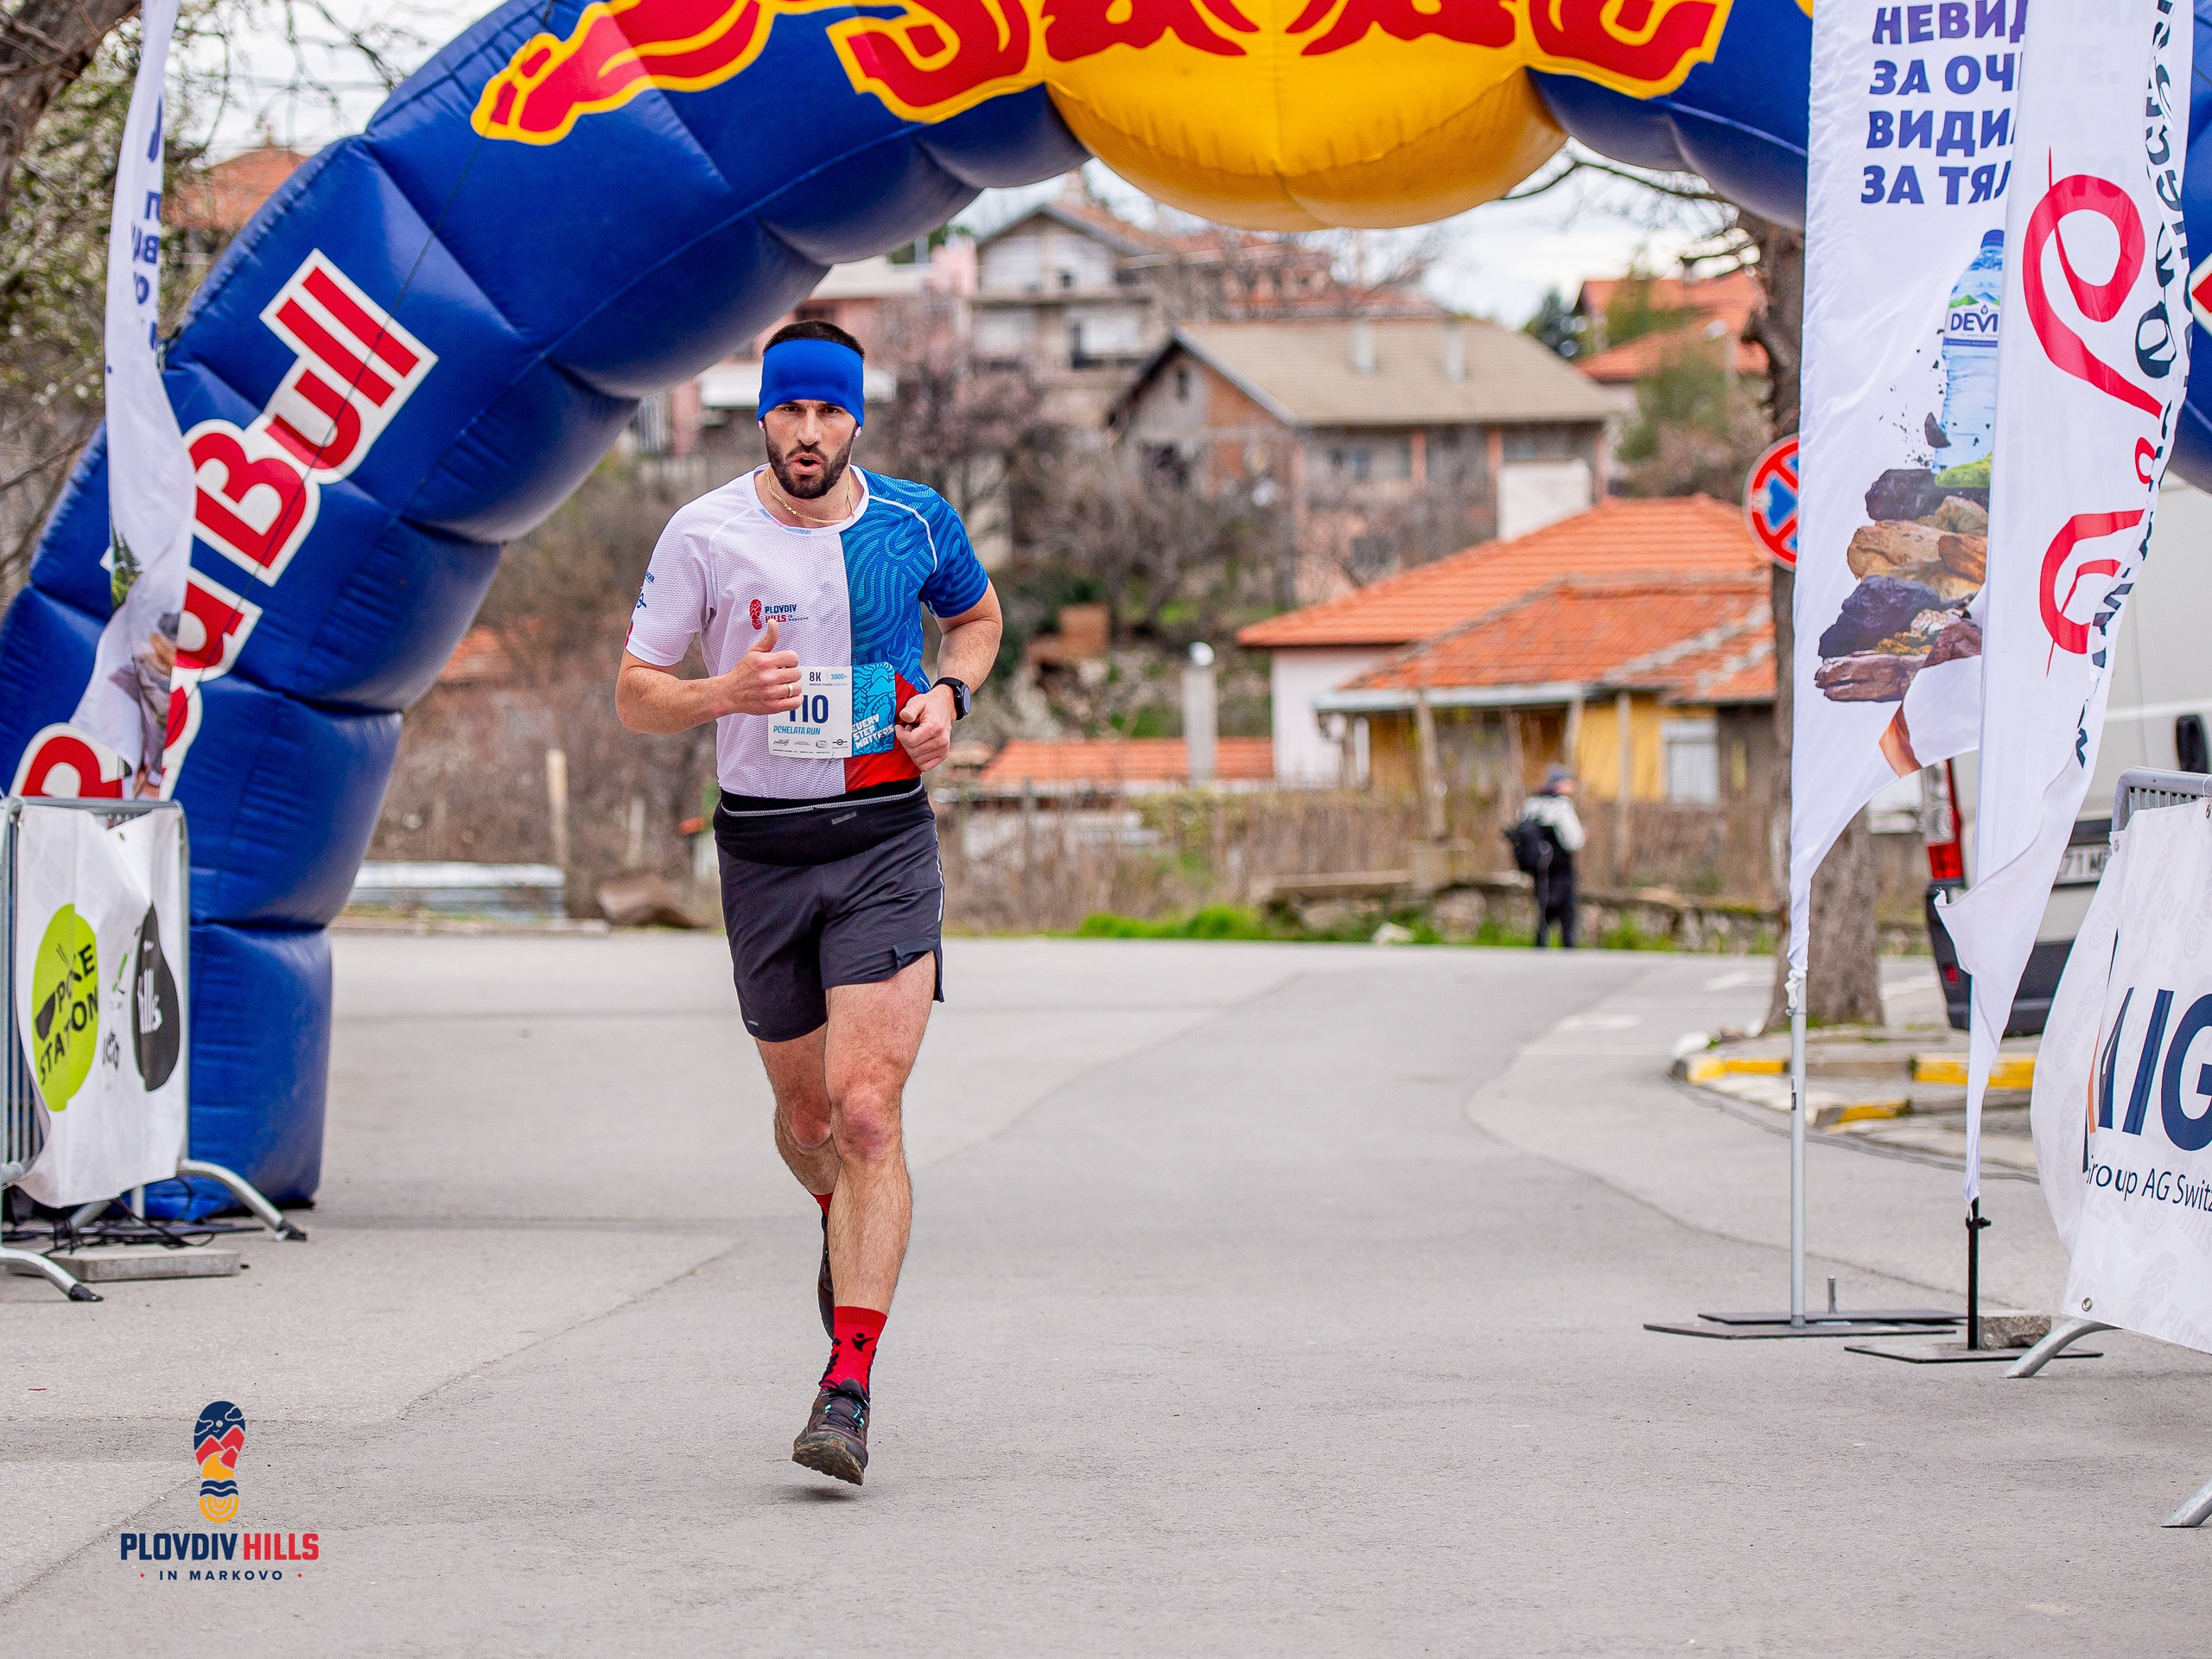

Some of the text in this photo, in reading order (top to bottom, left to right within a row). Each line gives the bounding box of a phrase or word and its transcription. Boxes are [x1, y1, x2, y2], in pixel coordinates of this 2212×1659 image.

[1869, 59, 1931, 95] ЗА
[1944, 52, 2024, 94] ОЧ
[1866, 107, 2016, 157] ВИДИ
[1860, 165, 1925, 204] ЗА
[185, 264, 423, 572] Bull
[764, 604, 797, 613] PLOVDIV
[809, 671, 822, 682] 8K
[772, 725, 821, 735] PCHELATA RUN
[852, 724, 875, 741] STEP
[2141, 1167, 2171, 1201] AG
